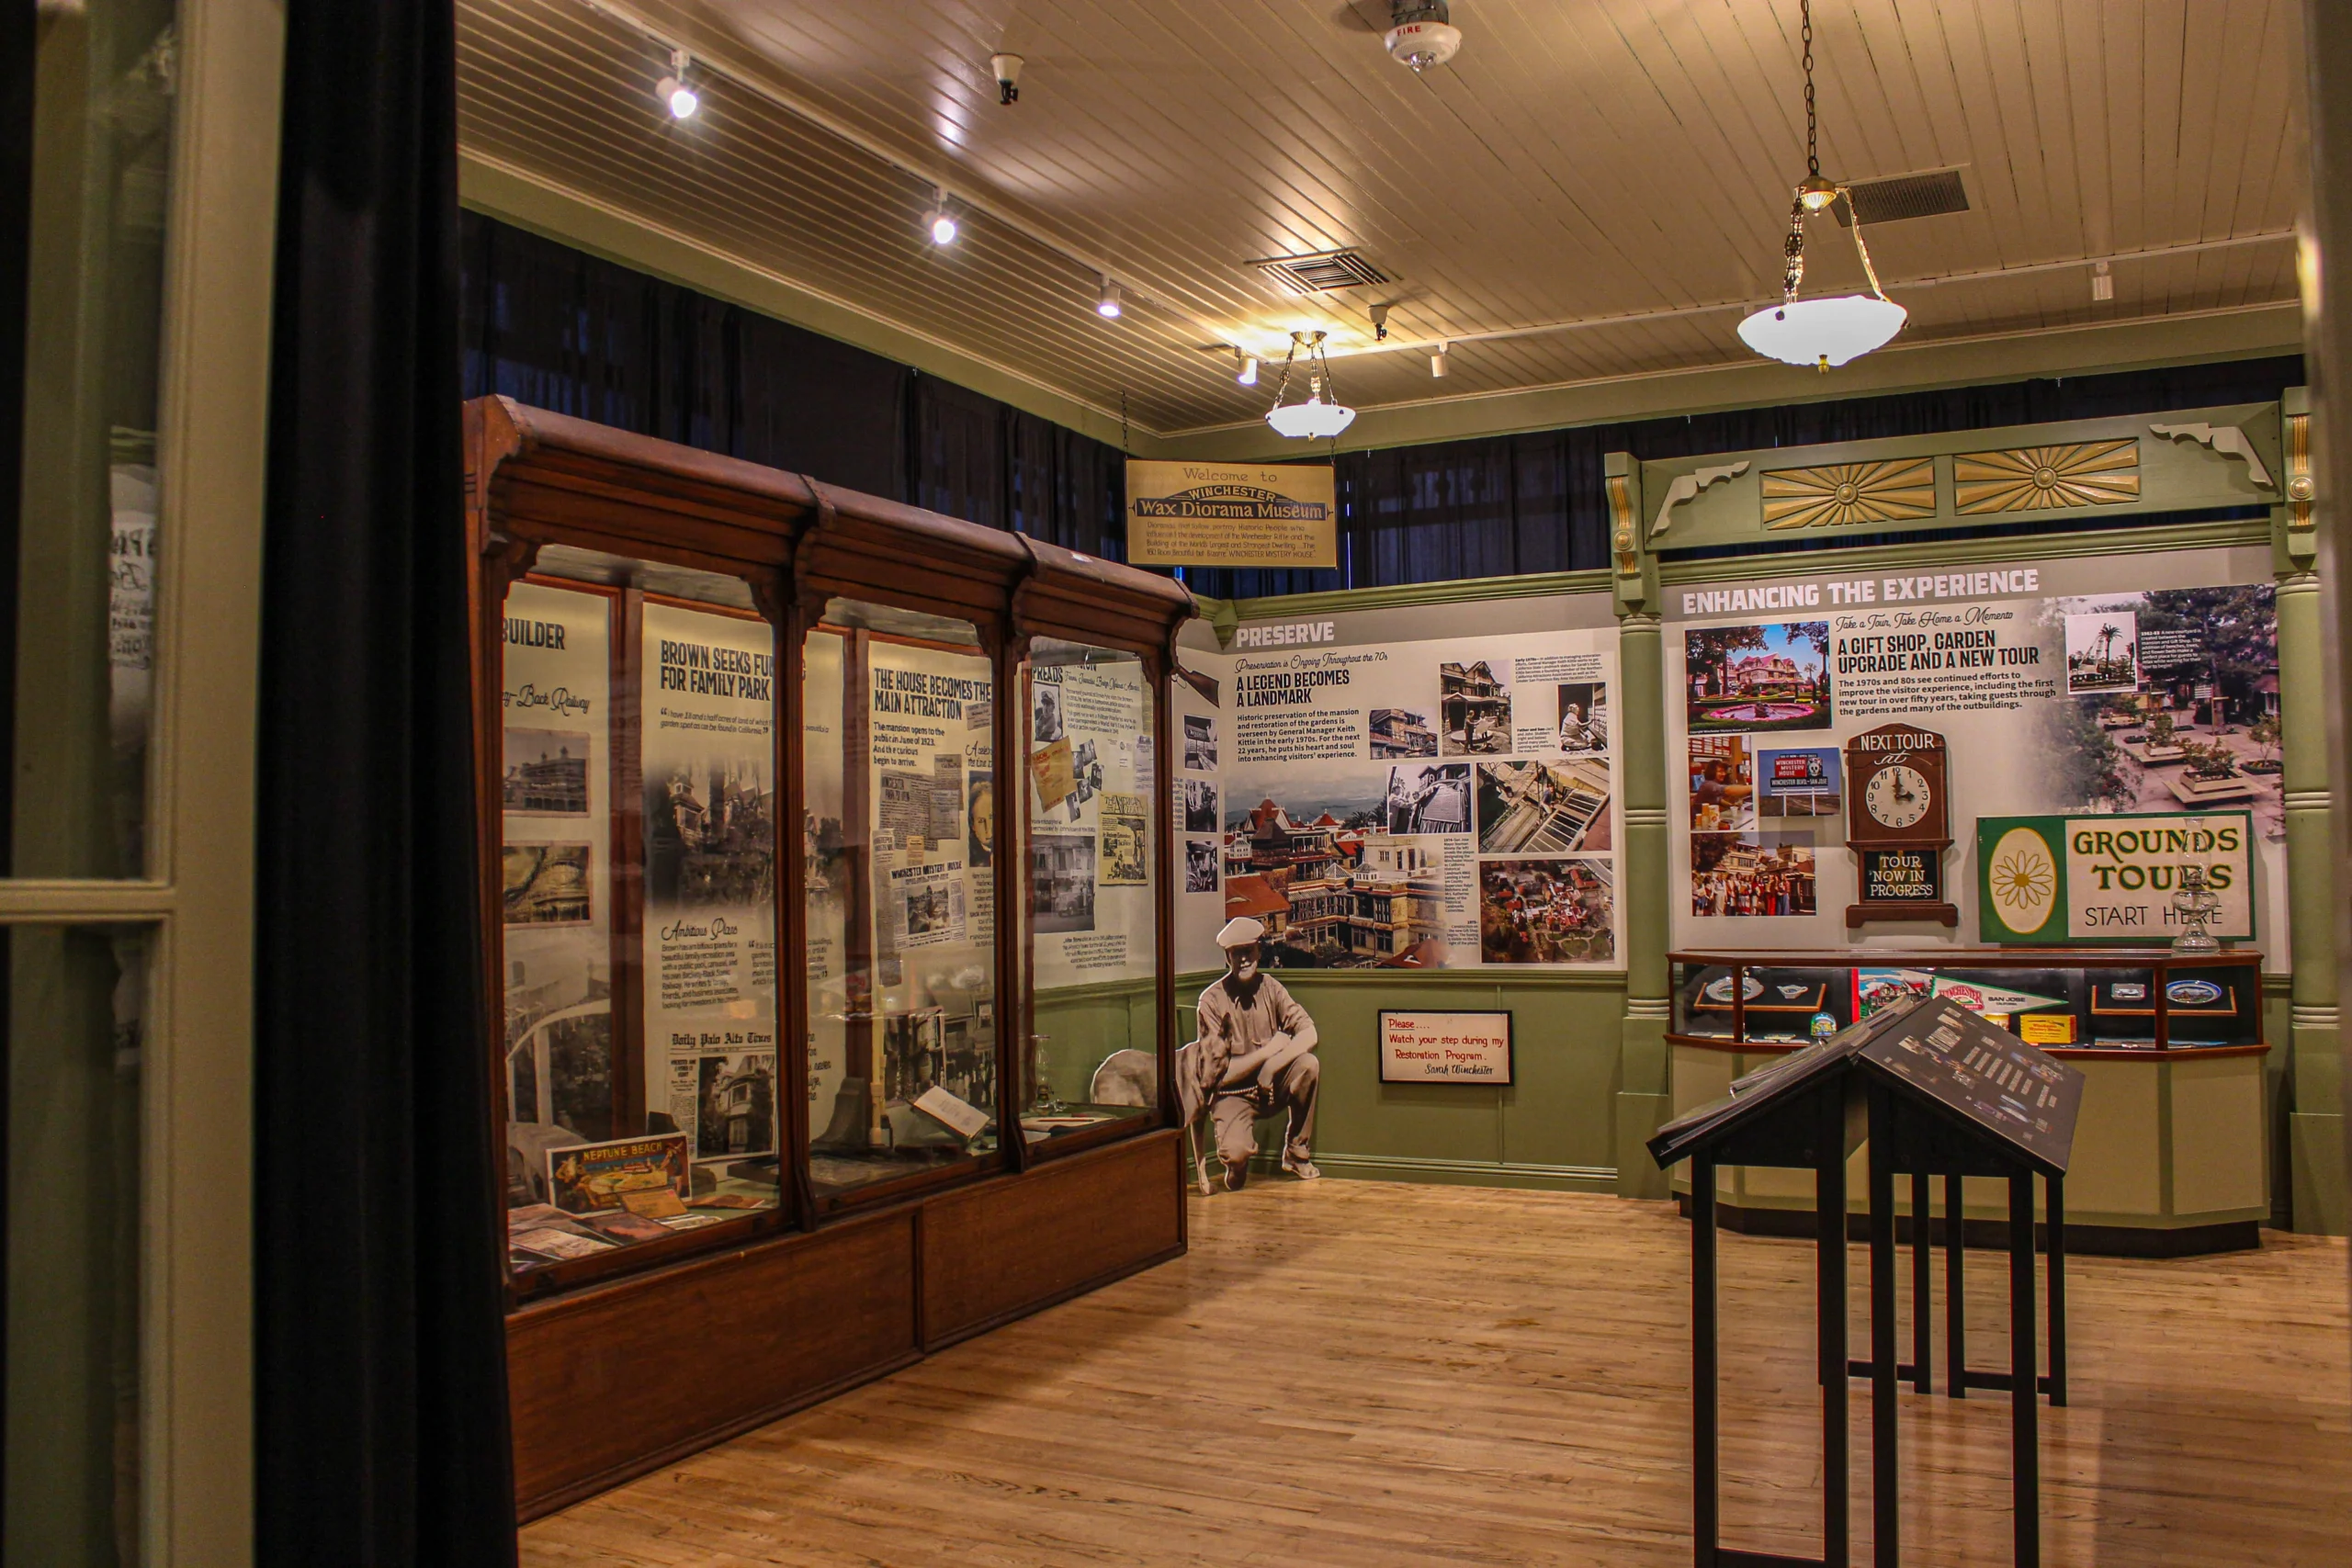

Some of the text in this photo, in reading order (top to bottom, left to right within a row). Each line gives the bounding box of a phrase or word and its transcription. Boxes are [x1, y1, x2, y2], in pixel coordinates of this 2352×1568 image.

[1396, 25, 1421, 37] FIRE
[1182, 467, 1278, 482] Welcome to
[1188, 486, 1276, 502] WINCHESTER
[1140, 500, 1323, 519] Wax Diorama Museum
[1682, 570, 2039, 615] ENHANCING THE EXPERIENCE
[1836, 616, 1858, 632] Take
[1867, 614, 1891, 631] Tour,
[1894, 612, 1917, 629] Take
[1917, 611, 1952, 628] Home
[1962, 606, 2013, 626] Memento
[1236, 621, 1334, 648] PRESERVE
[1838, 630, 1996, 656] A GIFT SHOP, GARDEN
[661, 639, 751, 674] BROWN SEEKS
[1235, 659, 1282, 673] Preservation
[1291, 654, 1320, 670] Ongoing
[1322, 652, 1361, 667] Throughout
[1374, 651, 1388, 661] 70s
[1838, 647, 2040, 674] UPGRADE AND A NEW TOUR
[661, 664, 771, 702] FOR FAMILY PARK
[874, 668, 991, 702] THE HOUSE BECOMES THE
[1236, 669, 1350, 692] A LEGEND BECOMES
[1856, 679, 1881, 687] 1970s
[1933, 673, 1978, 682] continued
[1838, 689, 1874, 698] improve
[1892, 686, 1919, 694] visitor
[1921, 684, 1973, 694] experience,
[1974, 682, 2017, 690] including
[549, 686, 590, 716] Railway
[1236, 688, 1312, 708] A LANDMARK
[874, 690, 901, 713] MAIN
[904, 694, 962, 721] ATTRACTION
[1237, 714, 1262, 722] Historic
[1264, 711, 1306, 722] preservation
[1329, 708, 1360, 716] mansion
[886, 724, 910, 733] mansion
[911, 727, 928, 735] opens
[1251, 720, 1288, 729] restoration
[1297, 718, 1309, 727] the
[1311, 718, 1338, 728] gardens
[1270, 729, 1277, 738] by
[1306, 727, 1335, 735] Manager
[874, 734, 891, 743] public
[899, 736, 913, 744] June
[921, 738, 935, 746] 1923.
[1277, 737, 1295, 745] early
[1860, 733, 1935, 751] NEXT TOUR
[874, 745, 919, 755] And the curious
[873, 755, 889, 766] begin
[898, 759, 917, 767] arrive.
[1874, 750, 1910, 765] at
[1880, 771, 1887, 780] 11
[1907, 770, 1912, 778] 1
[1871, 781, 1880, 790] 10
[1917, 778, 1924, 787] 2
[1868, 792, 1874, 802] 9
[1921, 791, 1928, 801] 3
[1871, 804, 1877, 814] 8
[1918, 804, 1925, 812] 4
[1882, 815, 1888, 823] 7
[1895, 818, 1902, 827] 6
[1908, 814, 1915, 822] 5
[2073, 827, 2239, 863] GROUNDS
[1880, 855, 1923, 868] TOUR
[1872, 870, 1926, 882] NOW IN
[2090, 863, 2233, 890] TOURS
[1870, 884, 1933, 897] PROGRESS
[2085, 906, 2148, 927] START
[661, 917, 738, 942] Ambitious Plans
[672, 1032, 772, 1048] Daily Palo Alto Times
[1389, 1034, 1504, 1048] Watch your step during my
[1395, 1048, 1487, 1063] Restoration Program.
[1425, 1064, 1495, 1077] Sarah Winchester
[583, 1141, 662, 1162] NEPTUNE BEACH
